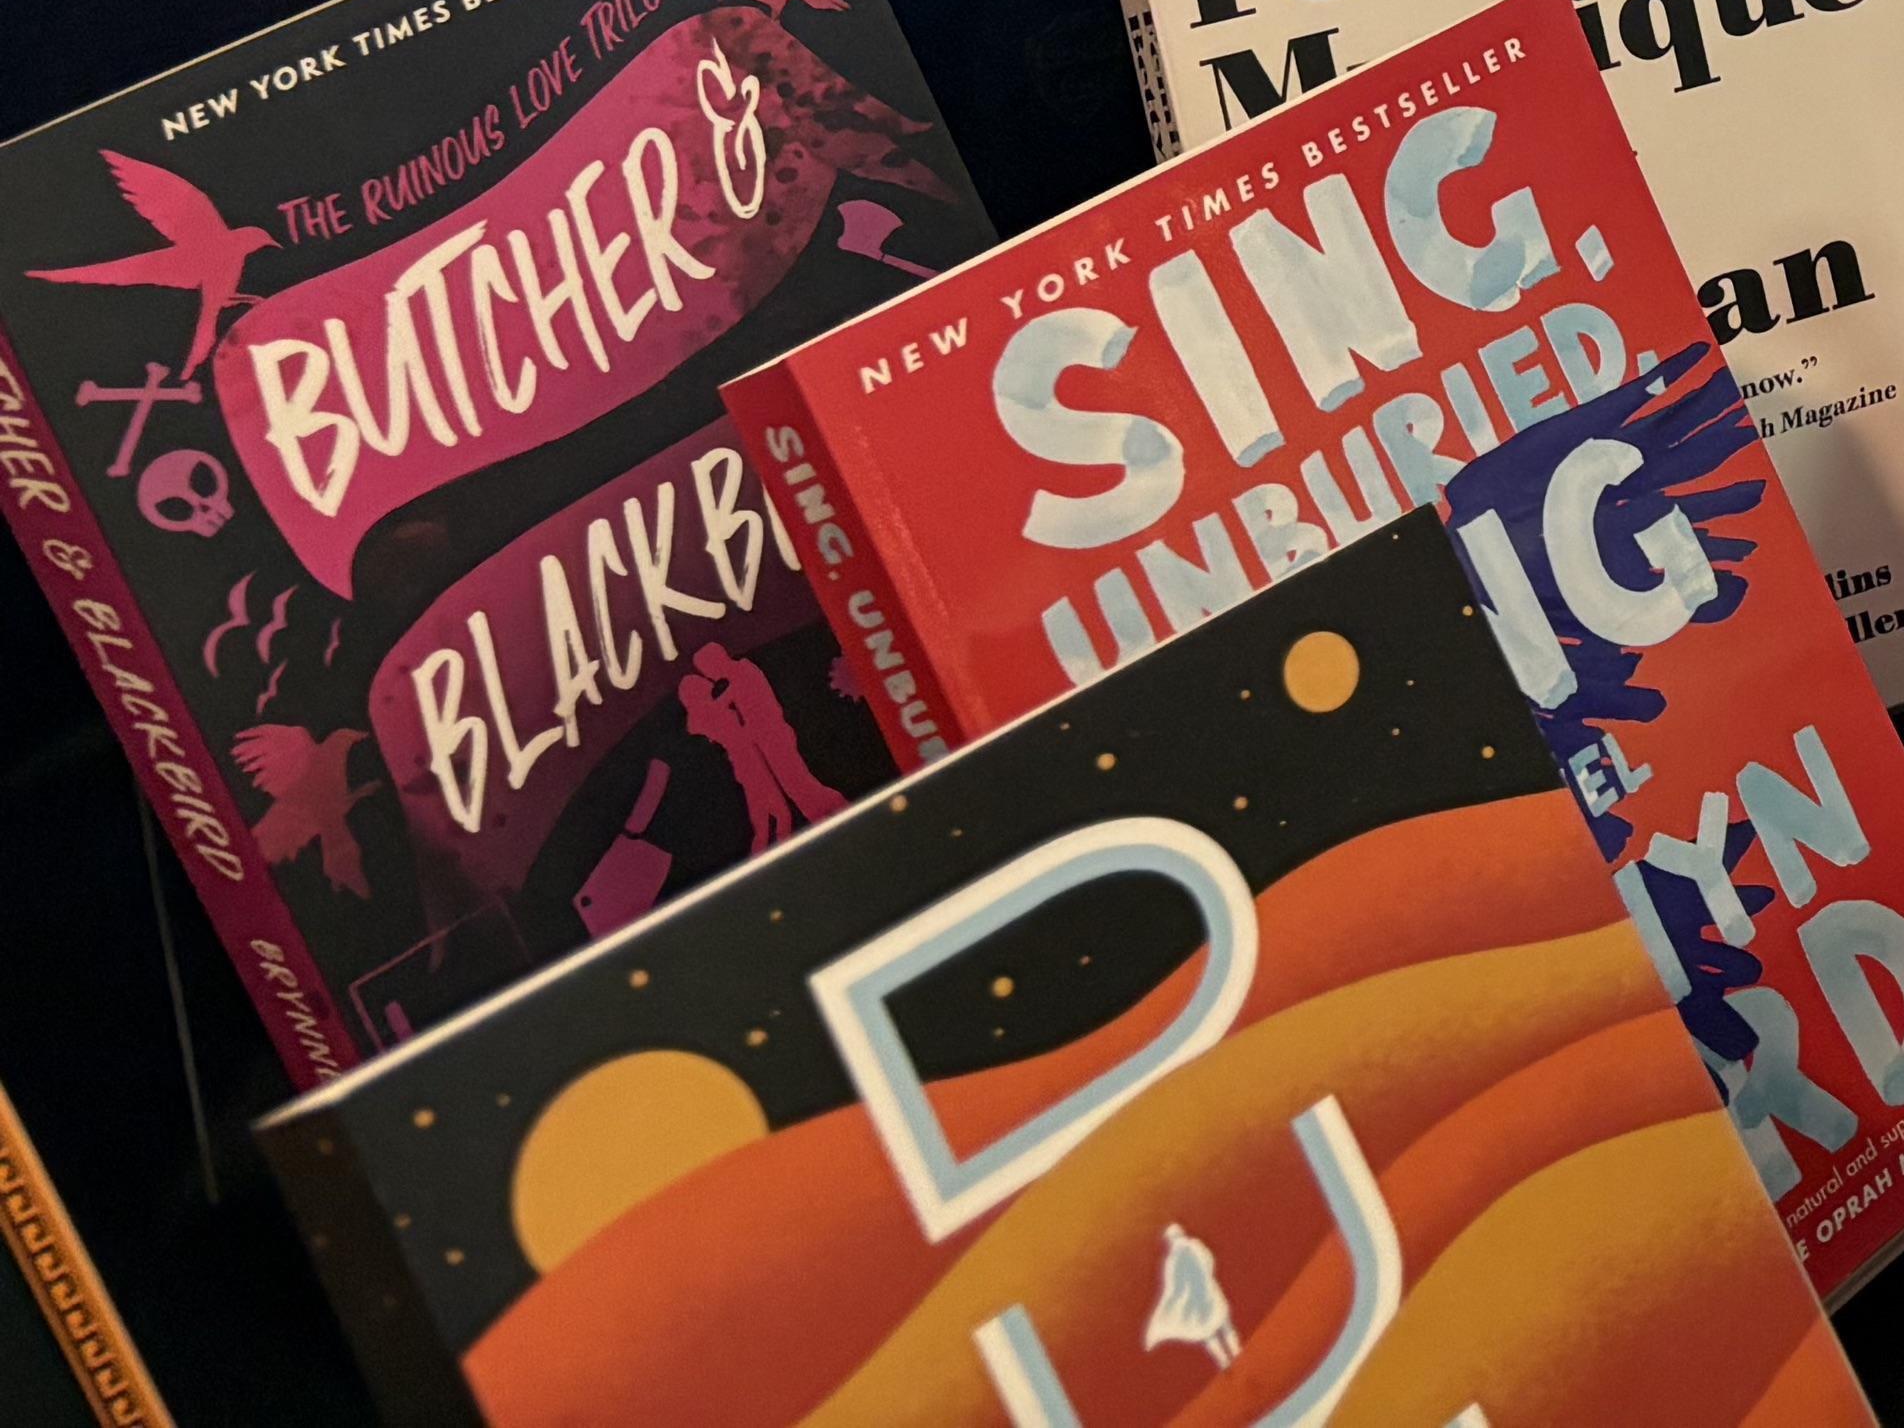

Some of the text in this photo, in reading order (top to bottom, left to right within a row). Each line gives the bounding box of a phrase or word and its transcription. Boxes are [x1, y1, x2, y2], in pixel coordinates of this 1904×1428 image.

[247, 34, 767, 519] BUTCHER &
[992, 103, 1616, 552] SING,
